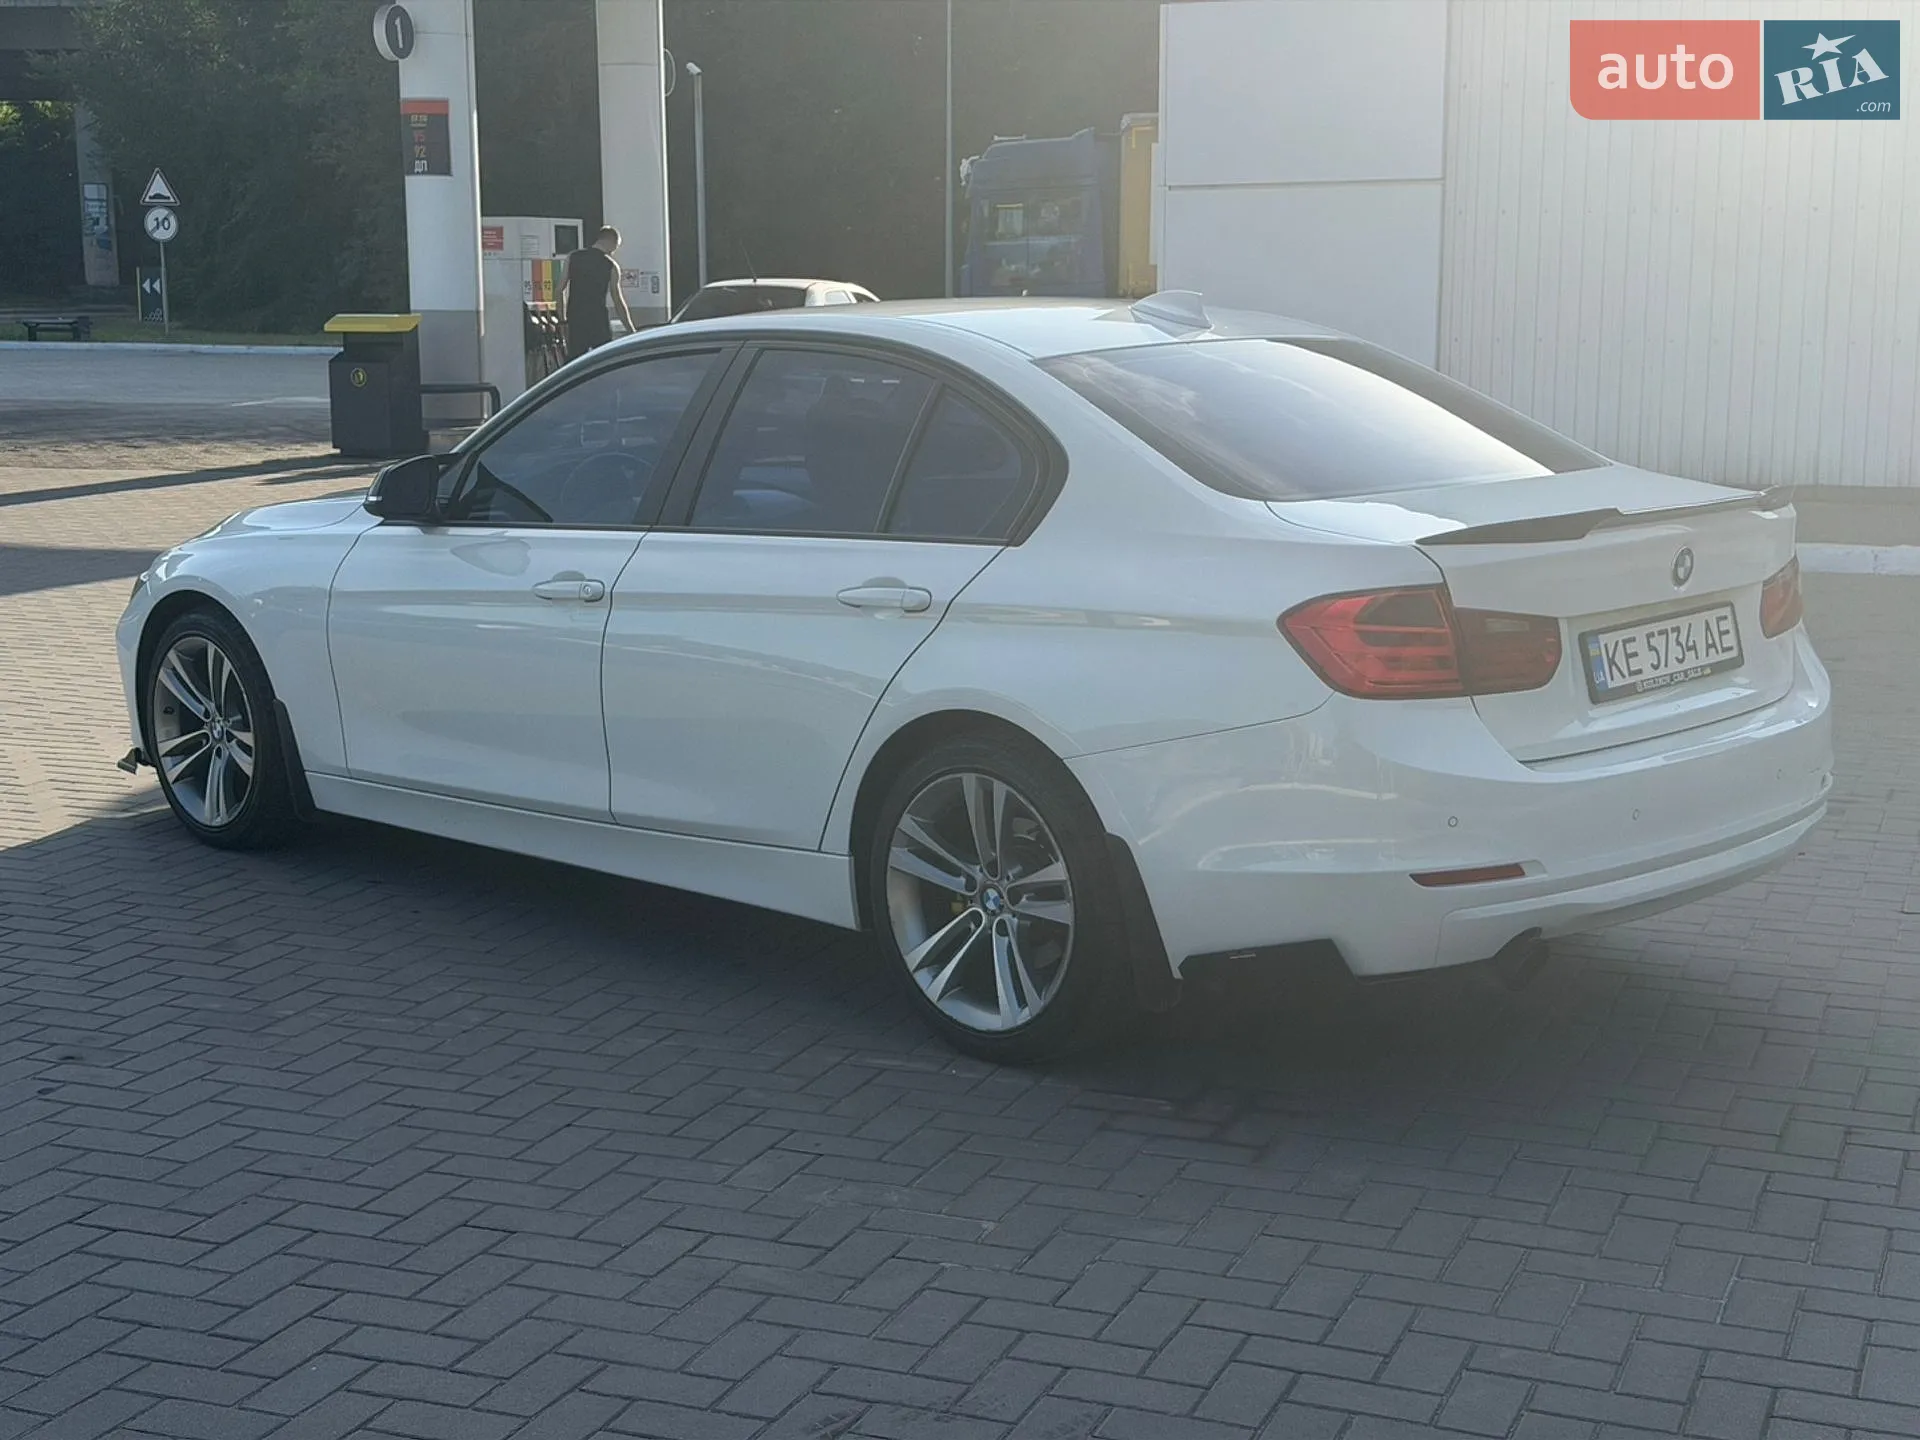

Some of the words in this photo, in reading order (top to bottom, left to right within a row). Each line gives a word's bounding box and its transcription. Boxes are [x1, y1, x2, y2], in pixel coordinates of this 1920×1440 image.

[395, 16, 403, 48] 1
[153, 217, 171, 231] 10
[1604, 637, 1643, 681] KE
[1645, 622, 1699, 671] 5734
[1705, 615, 1734, 657] AE
